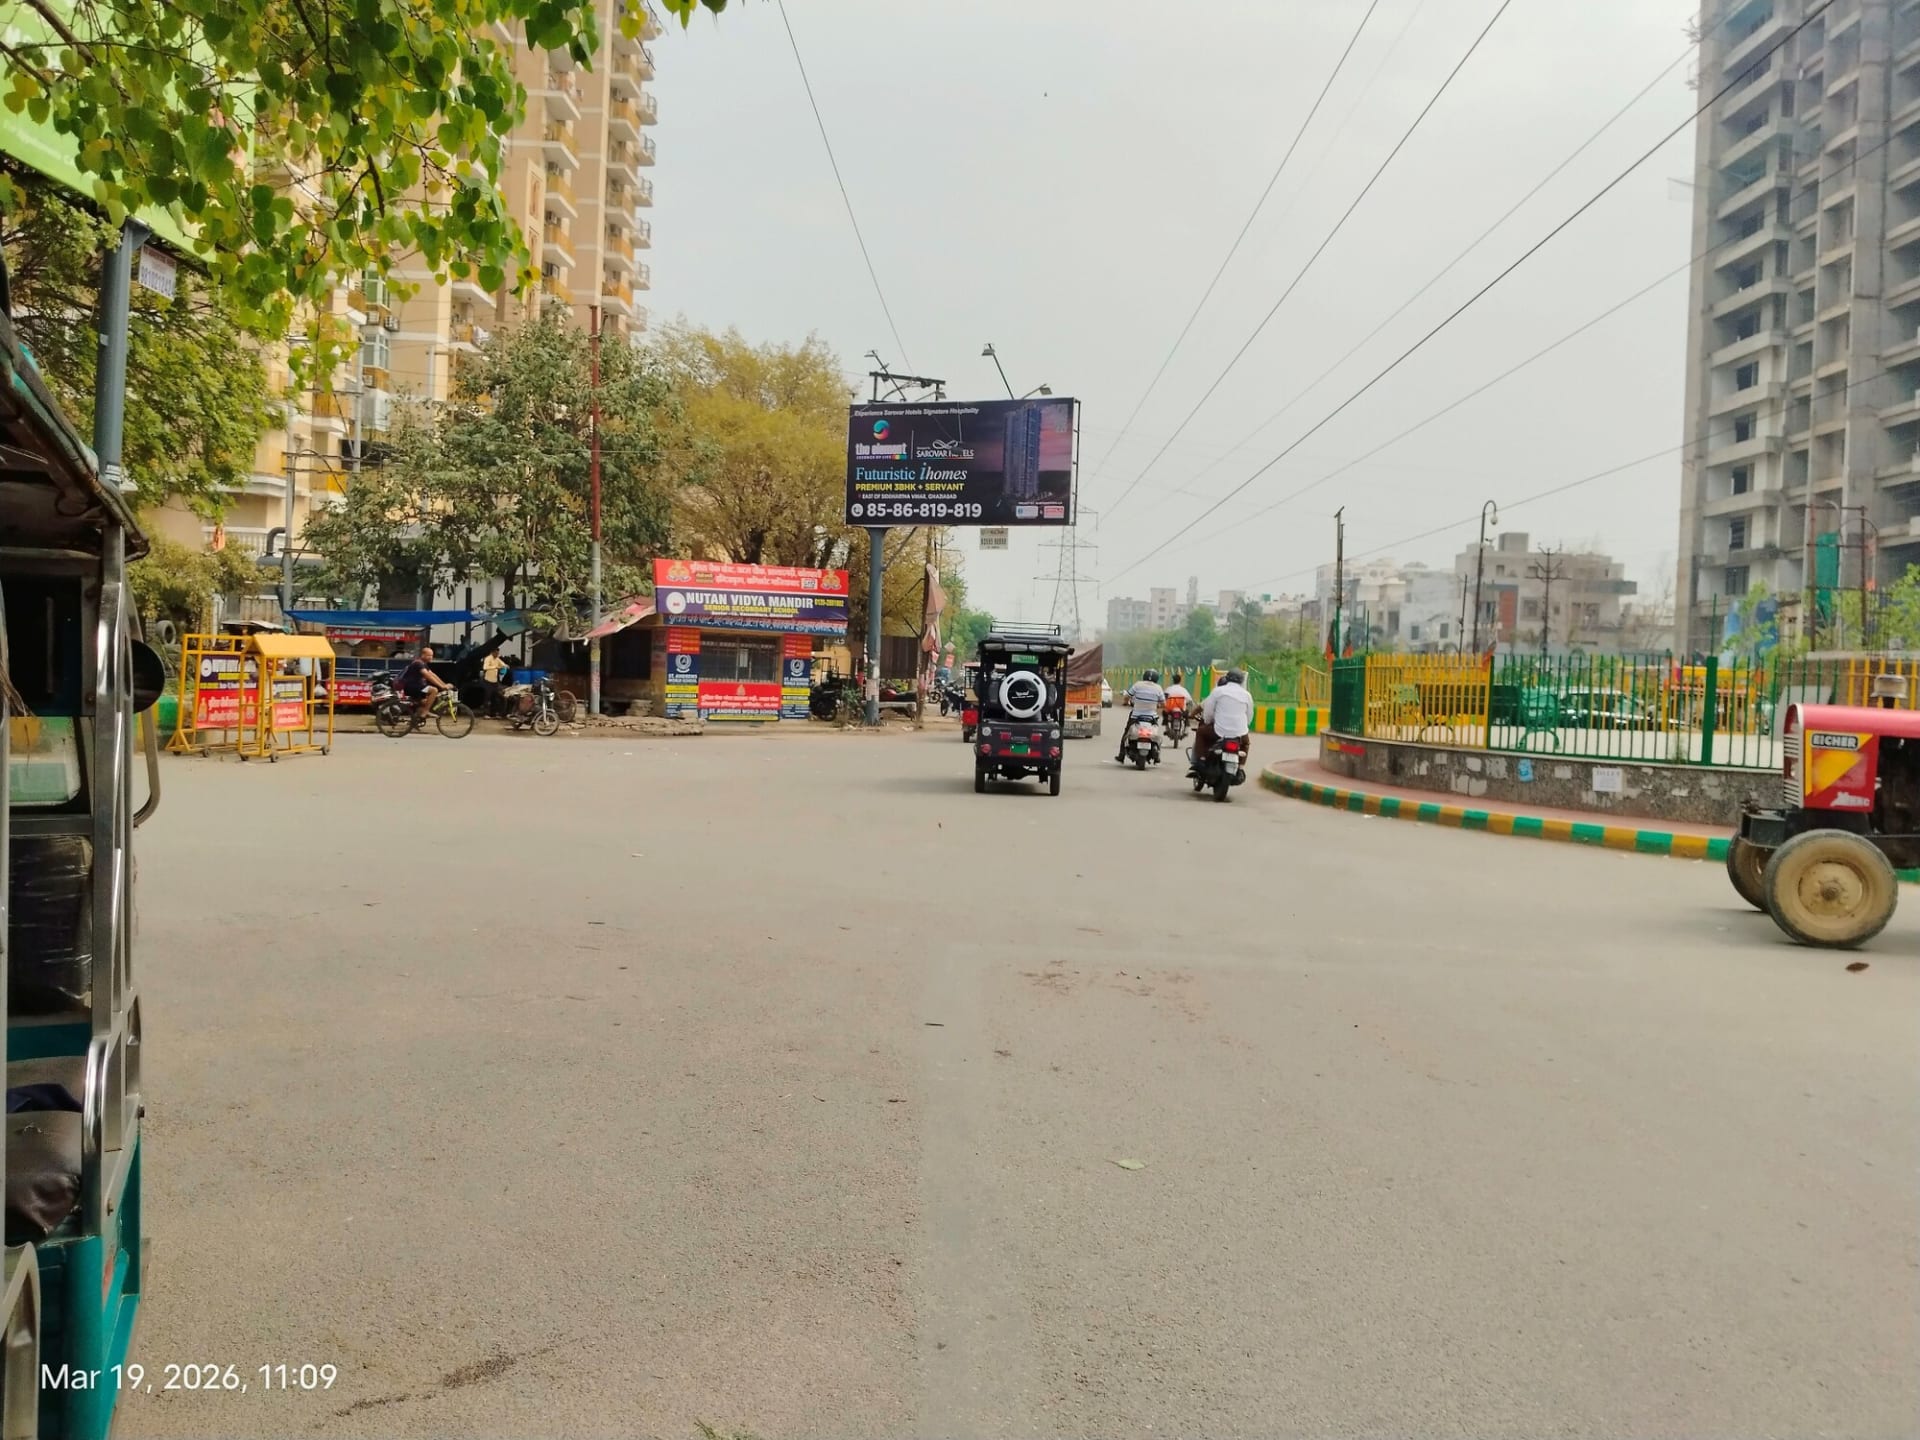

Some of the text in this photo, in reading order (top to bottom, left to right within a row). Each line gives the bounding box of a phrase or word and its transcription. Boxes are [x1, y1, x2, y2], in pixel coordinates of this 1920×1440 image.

[916, 449, 947, 458] SAROVAR
[855, 462, 968, 480] Futuristic ihomes
[855, 483, 893, 491] PREMIUM
[894, 483, 916, 491] 3BHK
[924, 483, 965, 491] SERVANT
[866, 502, 983, 518] 85-86-819-819
[686, 592, 727, 605] NUTAN
[730, 594, 766, 607] VIDYA
[768, 596, 814, 609] MANDIR
[1812, 735, 1857, 748] EICHER
